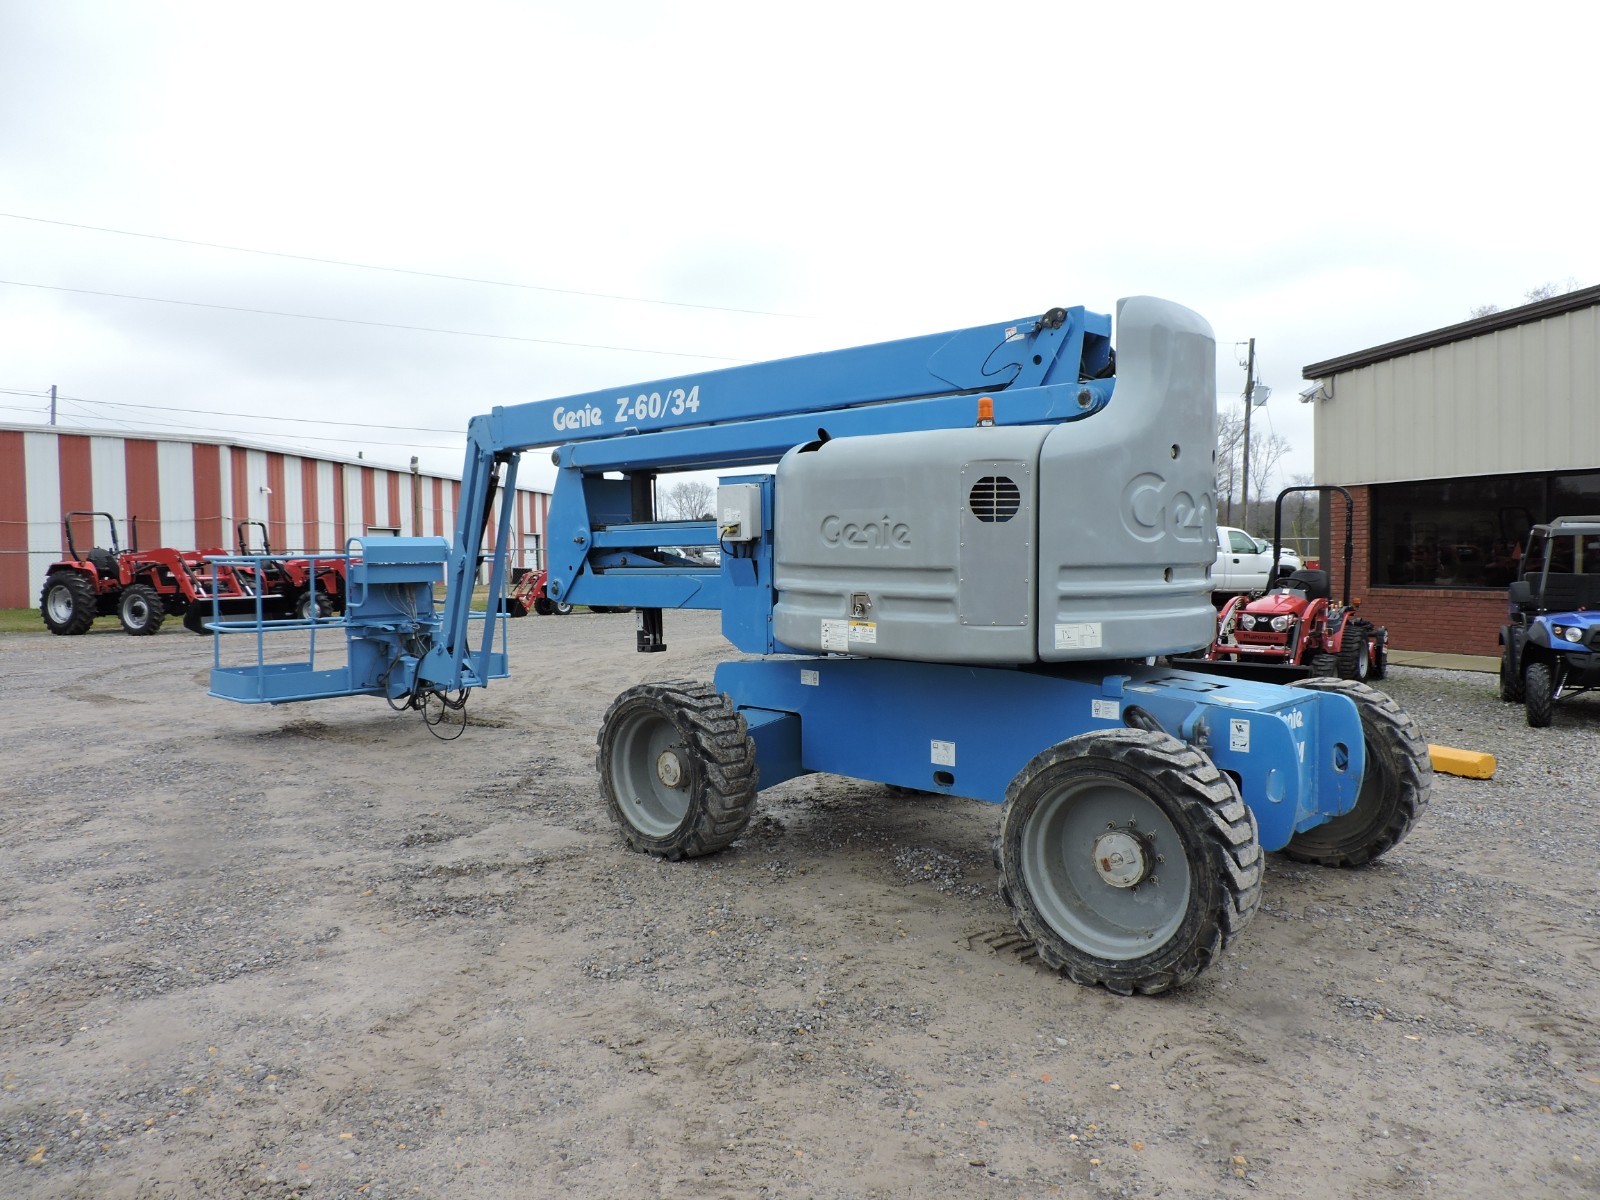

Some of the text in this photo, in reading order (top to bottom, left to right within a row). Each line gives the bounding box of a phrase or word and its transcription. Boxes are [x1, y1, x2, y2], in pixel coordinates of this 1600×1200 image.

[552, 385, 700, 431] Genie Z-60/34
[1119, 471, 1216, 543] Gen
[820, 514, 911, 549] Genie
